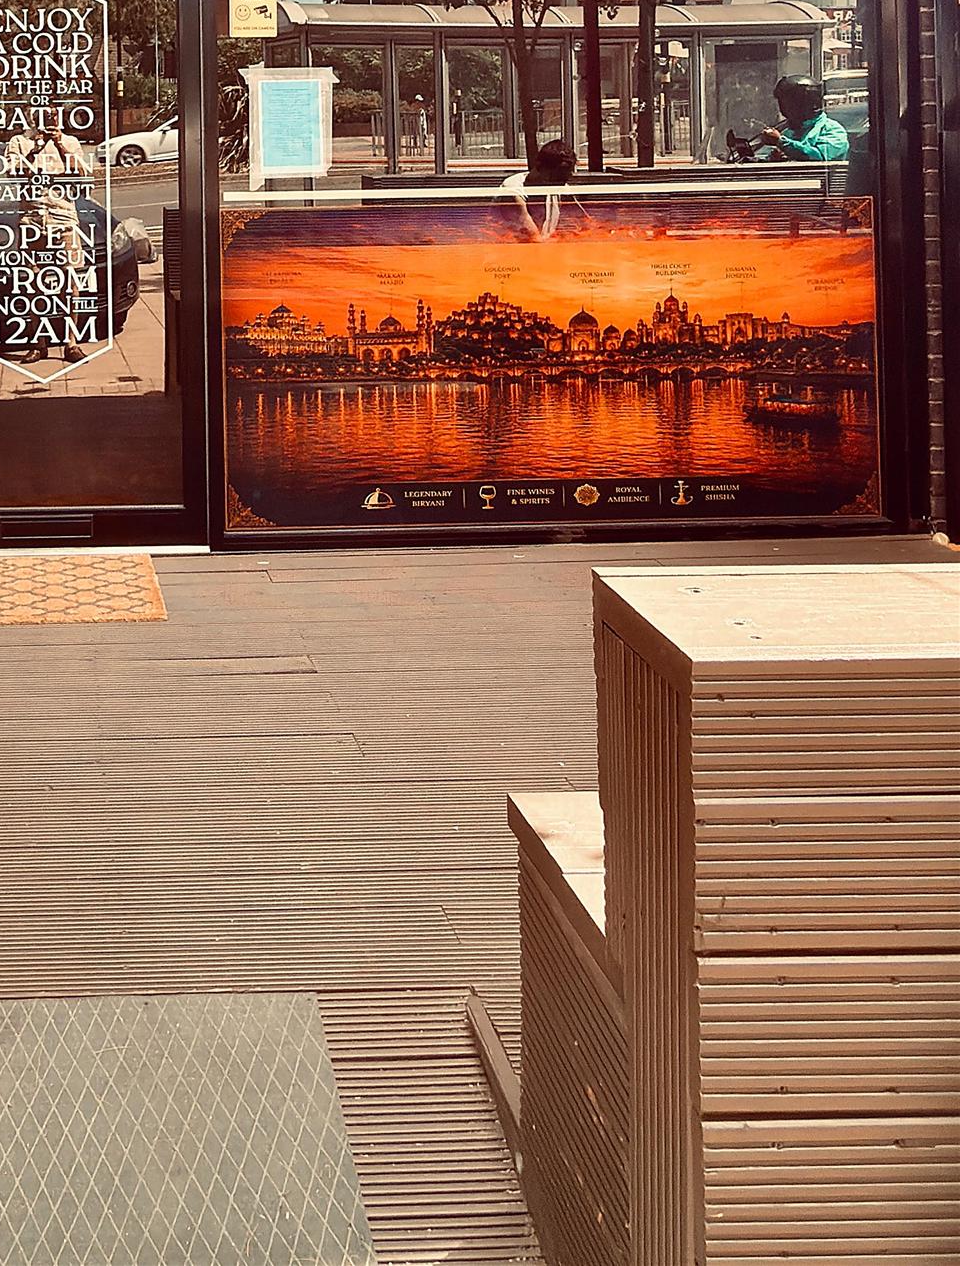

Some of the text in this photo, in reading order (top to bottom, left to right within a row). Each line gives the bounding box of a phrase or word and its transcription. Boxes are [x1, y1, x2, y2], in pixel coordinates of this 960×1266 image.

[12, 32, 93, 54] COLD
[14, 80, 52, 94] THE
[56, 79, 93, 94] BAR
[30, 95, 49, 105] OR
[65, 153, 95, 174] IN
[31, 175, 50, 184] OR
[48, 184, 95, 200] OUT
[38, 254, 52, 262] TO
[56, 250, 96, 265] SUN
[72, 299, 98, 309] TILL
[404, 490, 453, 498] LEGENDARY
[607, 495, 650, 503] AMBIENCE
[705, 493, 736, 501] SHISHA
[412, 499, 445, 507] BIRYANI
[519, 497, 550, 505] SPIRITS
